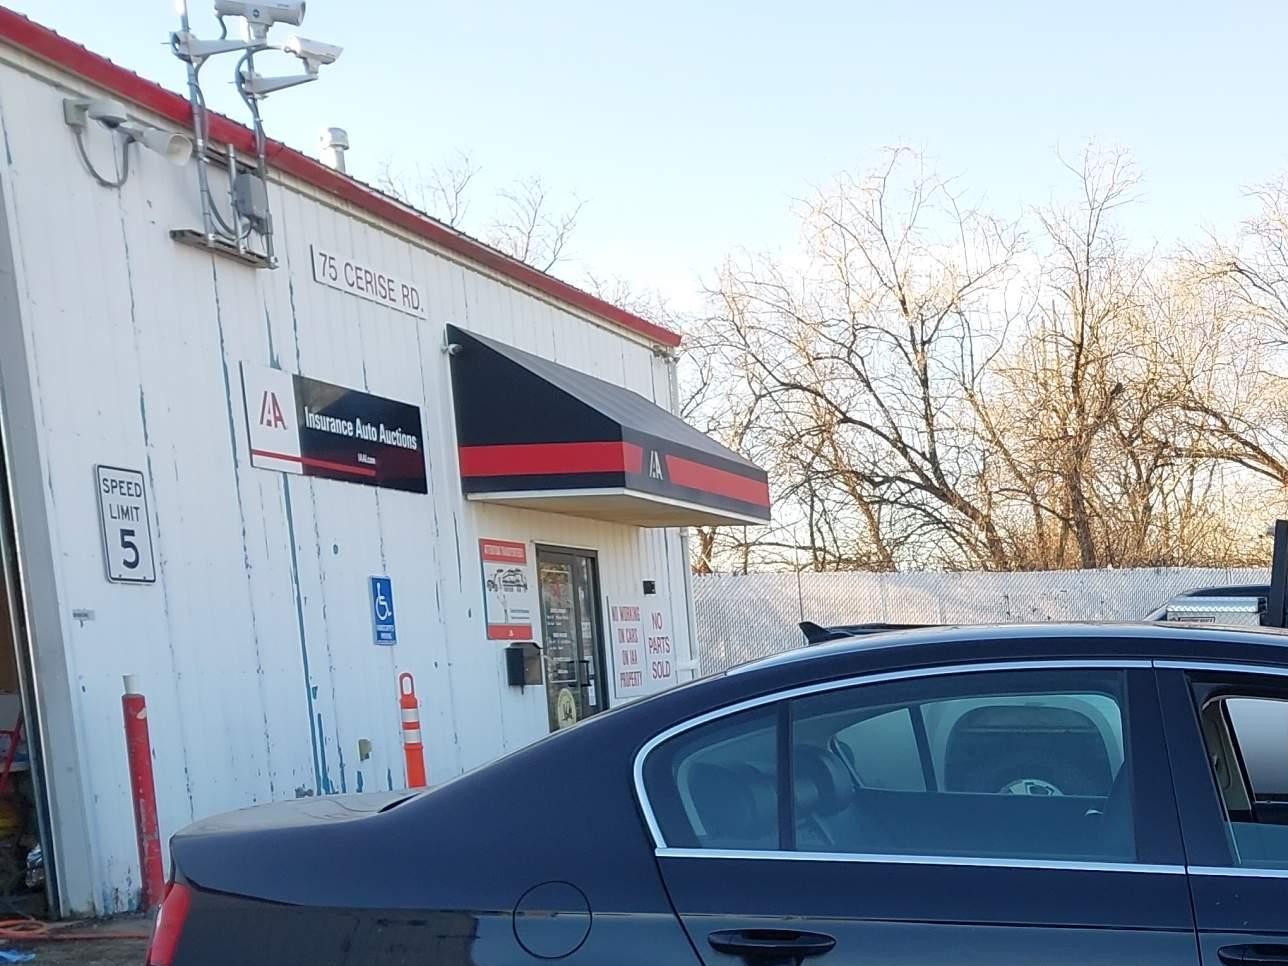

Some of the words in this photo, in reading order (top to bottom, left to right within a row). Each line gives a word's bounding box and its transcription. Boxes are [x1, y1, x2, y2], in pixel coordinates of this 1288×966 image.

[344, 262, 397, 303] CERISE
[401, 283, 424, 312] RD.
[304, 405, 354, 437] Insurance
[355, 417, 378, 442] Auto
[379, 424, 418, 451] Auctions
[102, 478, 142, 498] SPEED
[109, 503, 140, 522] LIMIT
[119, 528, 140, 570] 5
[651, 612, 663, 630] NO
[626, 628, 639, 643] CARS
[648, 636, 671, 655] PARTS
[620, 671, 642, 688] PROPERTY
[652, 660, 671, 680] SOLD
